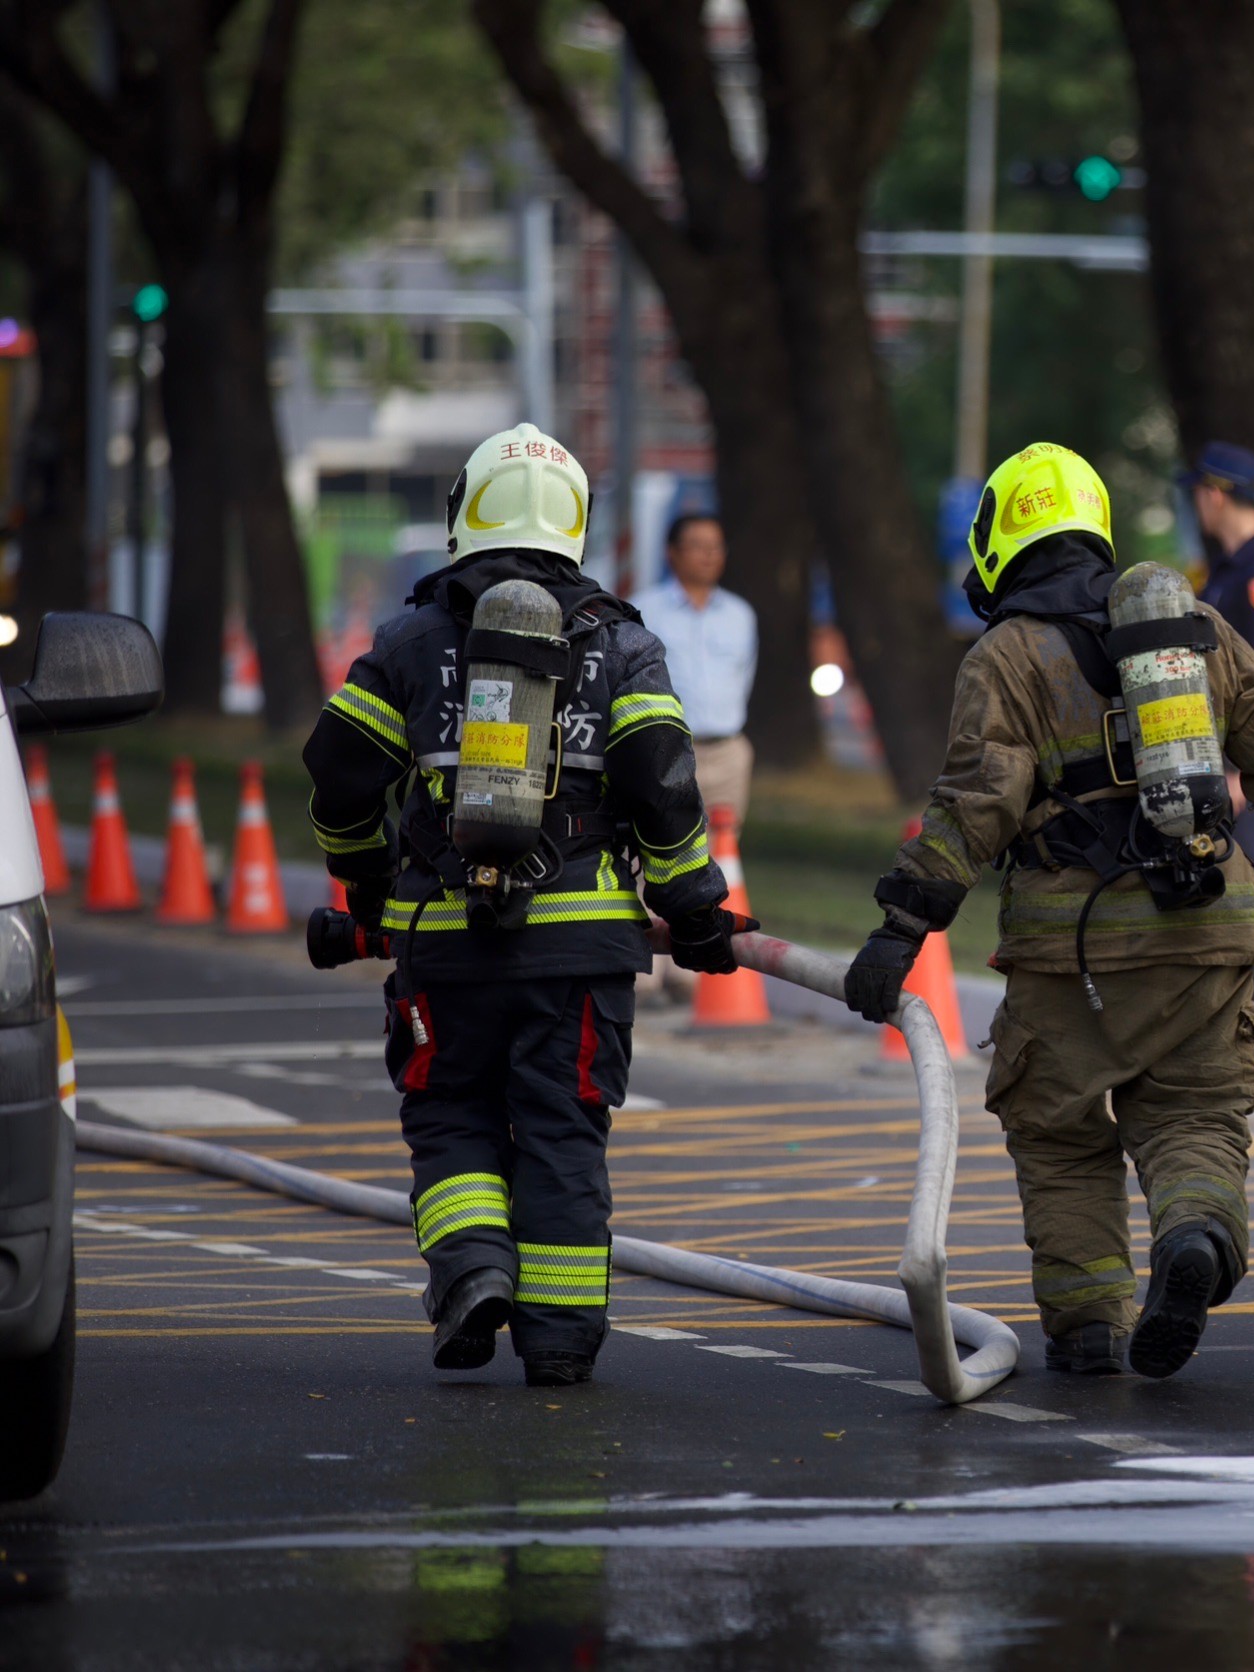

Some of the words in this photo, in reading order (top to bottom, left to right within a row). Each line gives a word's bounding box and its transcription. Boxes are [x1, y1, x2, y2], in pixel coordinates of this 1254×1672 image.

[500, 440, 568, 467] 王俊傑
[1016, 487, 1056, 518] 新莊
[488, 774, 520, 787] FENZY
